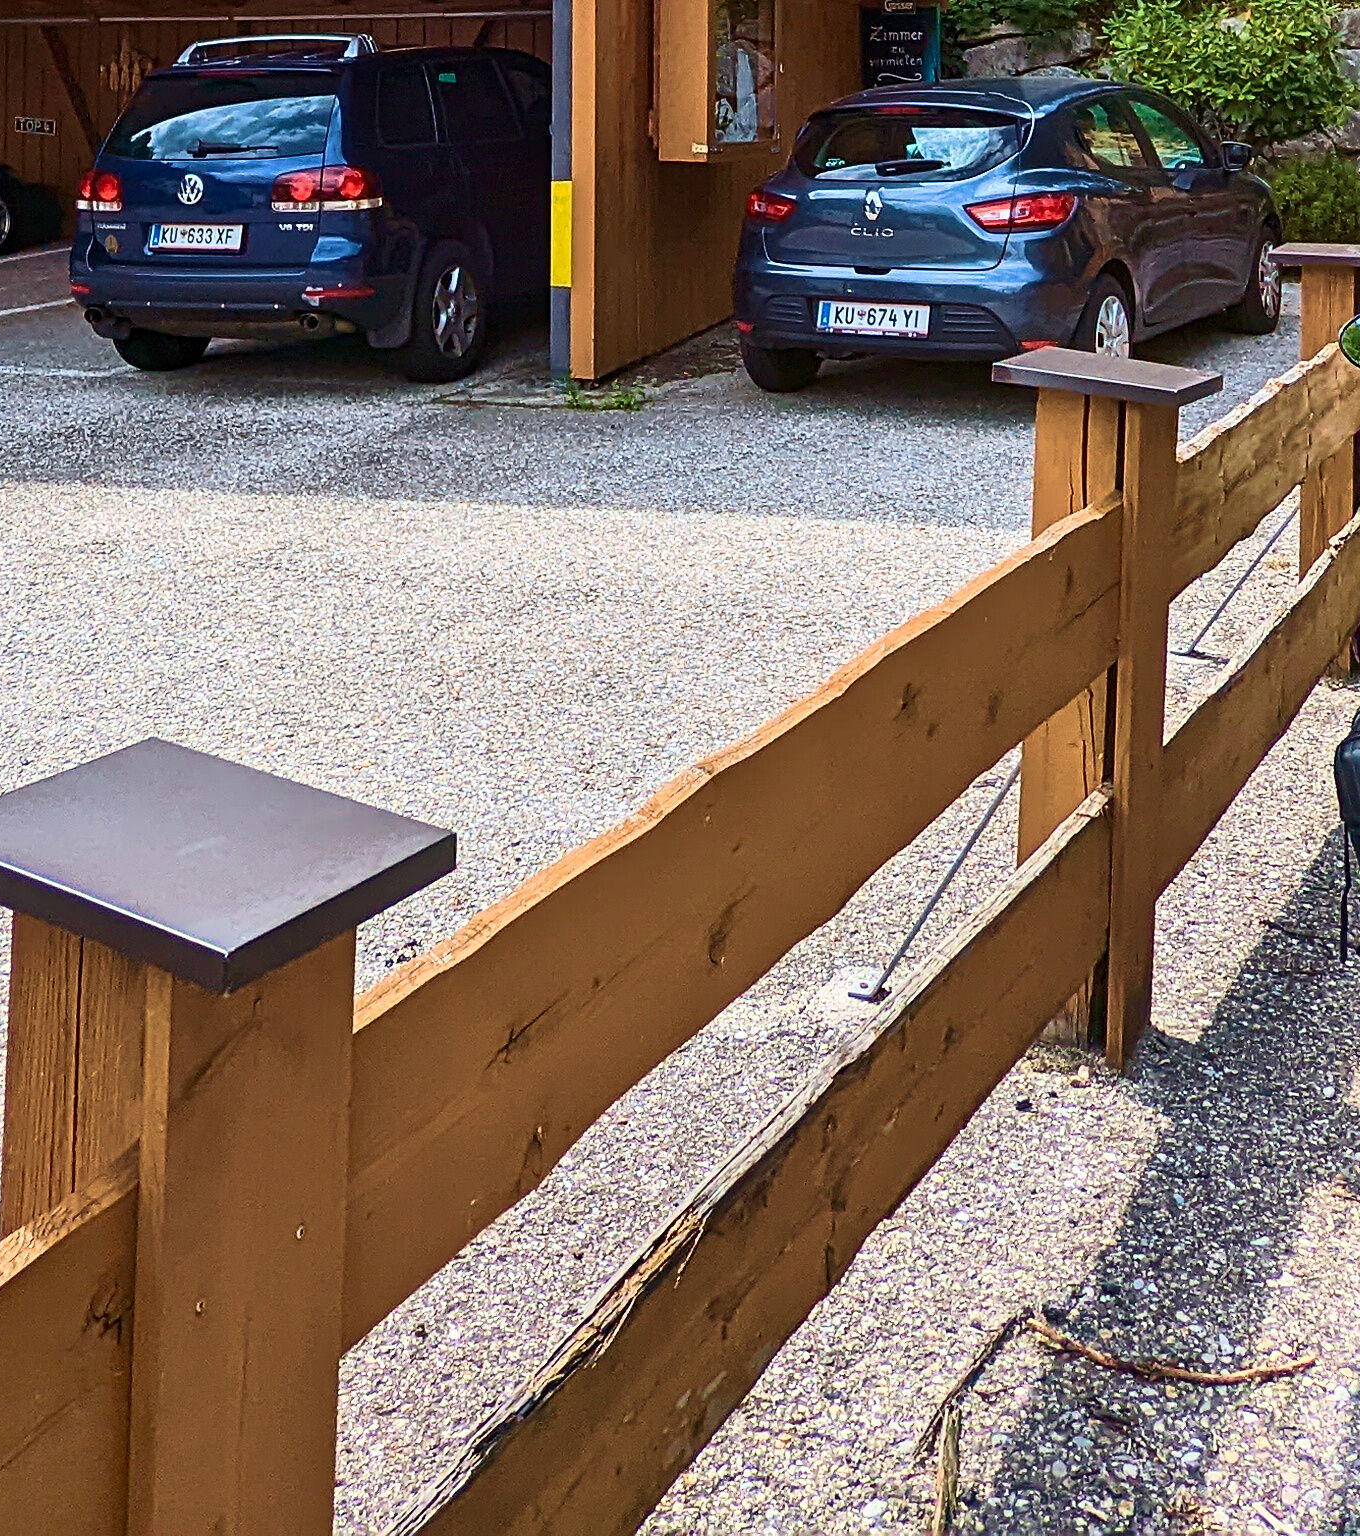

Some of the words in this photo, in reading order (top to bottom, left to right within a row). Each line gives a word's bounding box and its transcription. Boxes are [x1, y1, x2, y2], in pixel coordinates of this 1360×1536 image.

[869, 25, 924, 42] Zimmer
[891, 46, 905, 54] zu
[19, 118, 42, 132] TOP
[161, 227, 179, 244] KU
[187, 227, 213, 244] 633
[216, 228, 234, 244] XF
[850, 227, 894, 237] CLIO
[834, 306, 855, 325] KU
[867, 308, 898, 327] 674
[903, 309, 919, 328] YI
